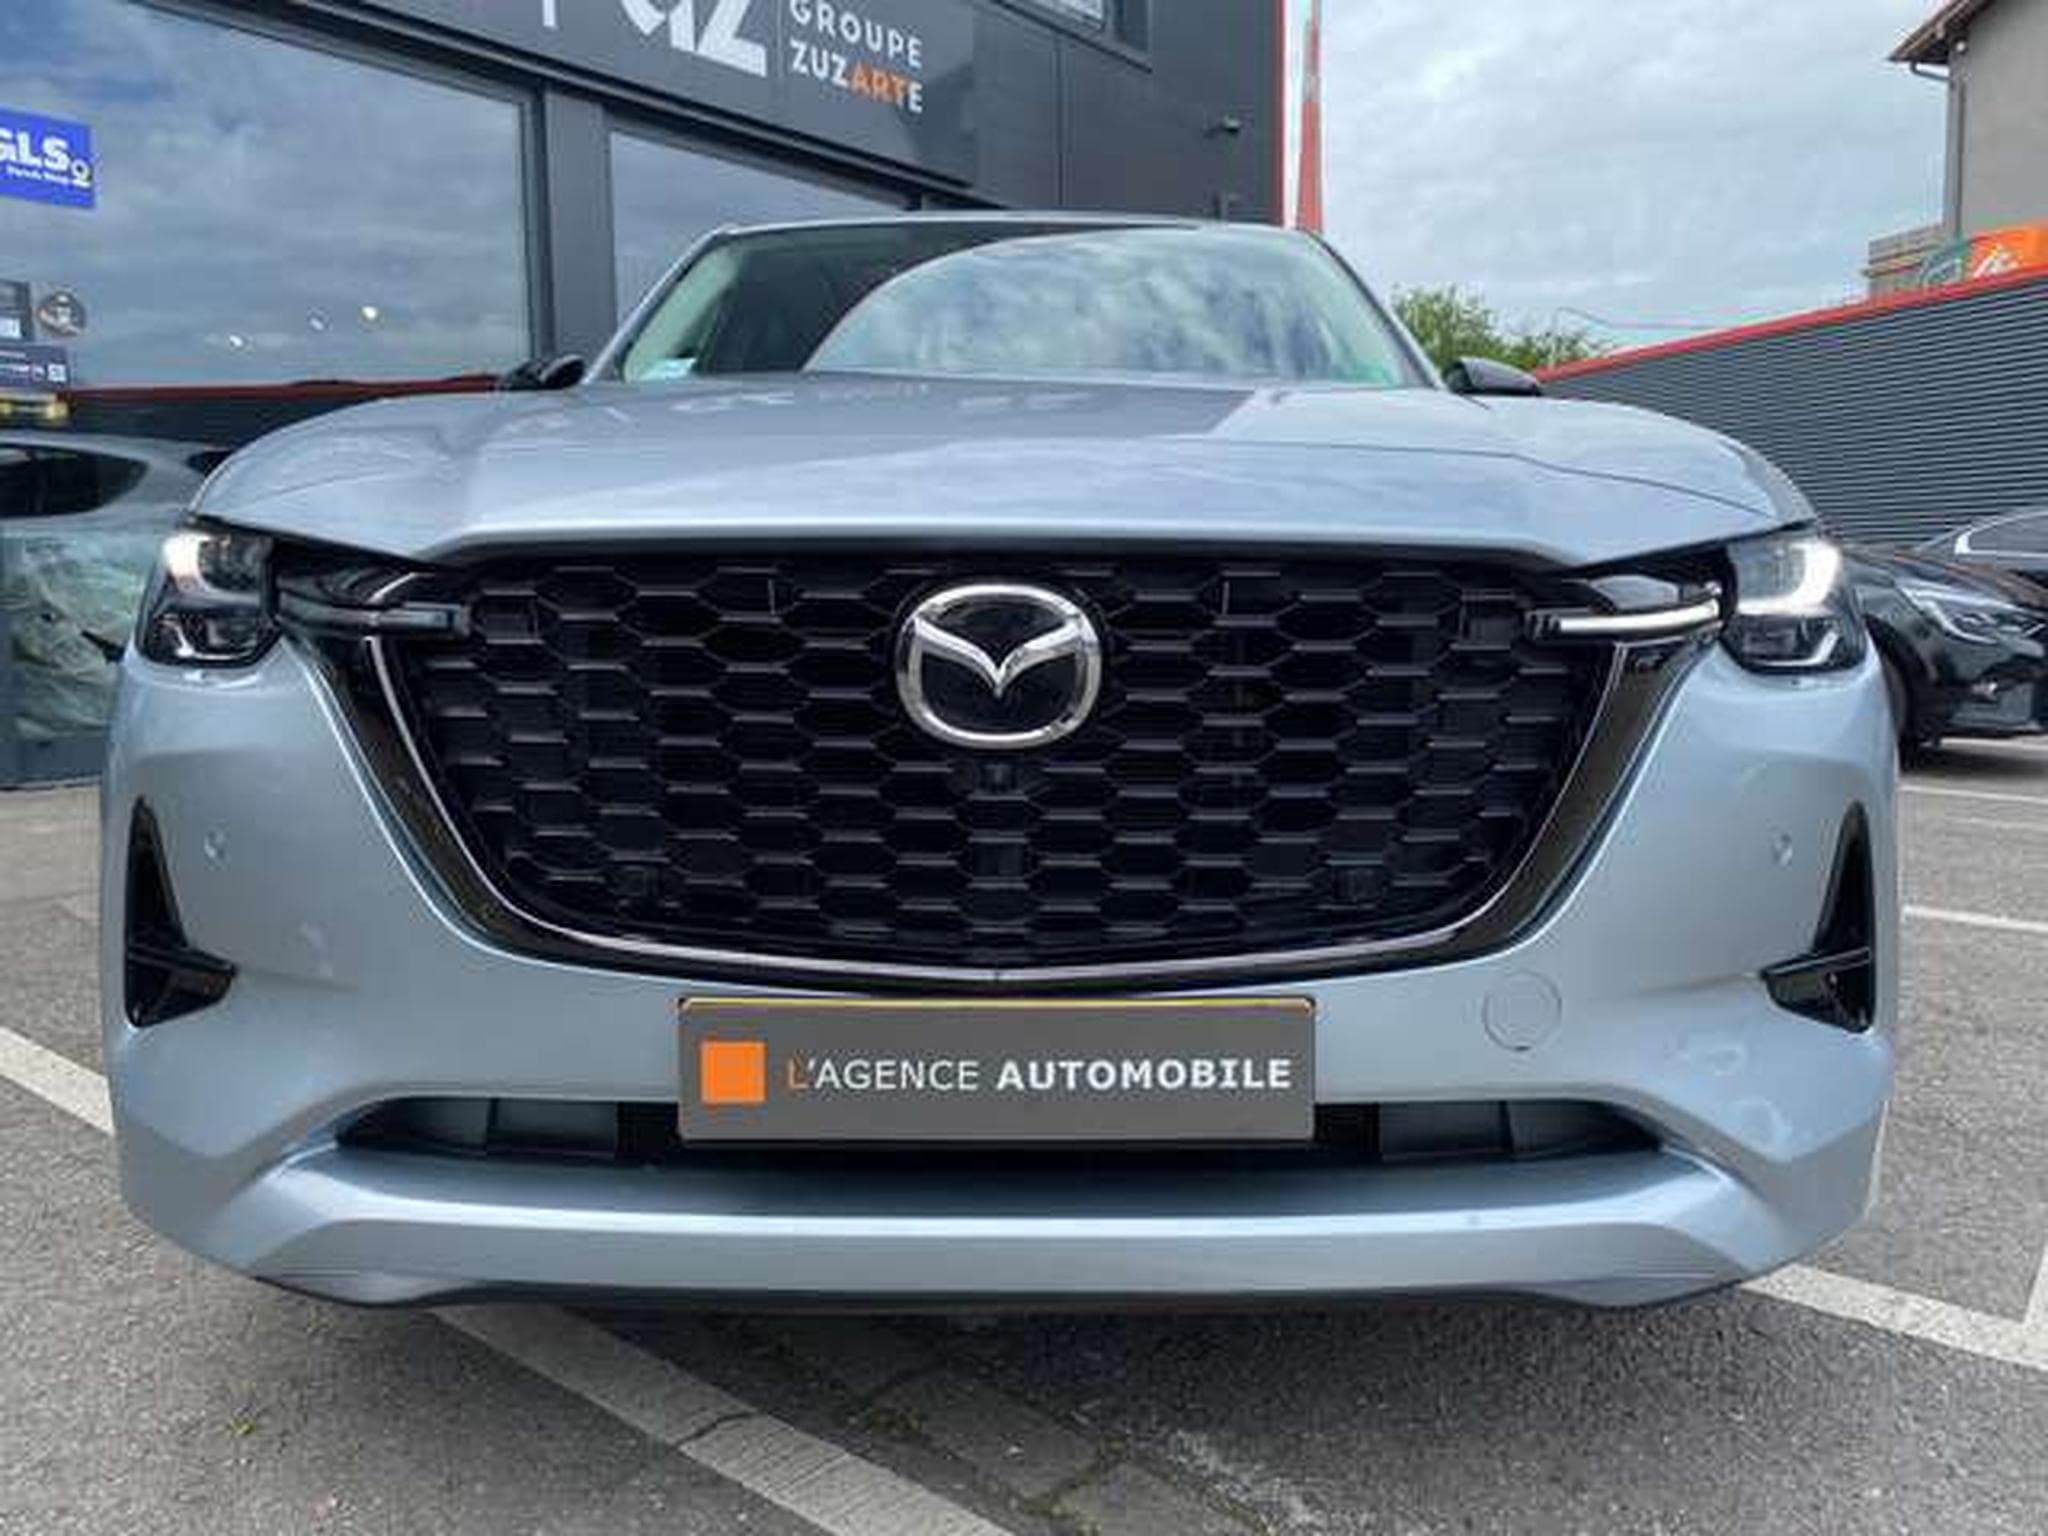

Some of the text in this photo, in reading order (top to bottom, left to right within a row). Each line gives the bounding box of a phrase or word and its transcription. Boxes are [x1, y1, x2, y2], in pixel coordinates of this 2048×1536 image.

[789, 0, 922, 70] GROUPE
[789, 36, 923, 113] ZUZARTE
[787, 1058, 1292, 1092] L'AGENCE AUTOMOBILE
